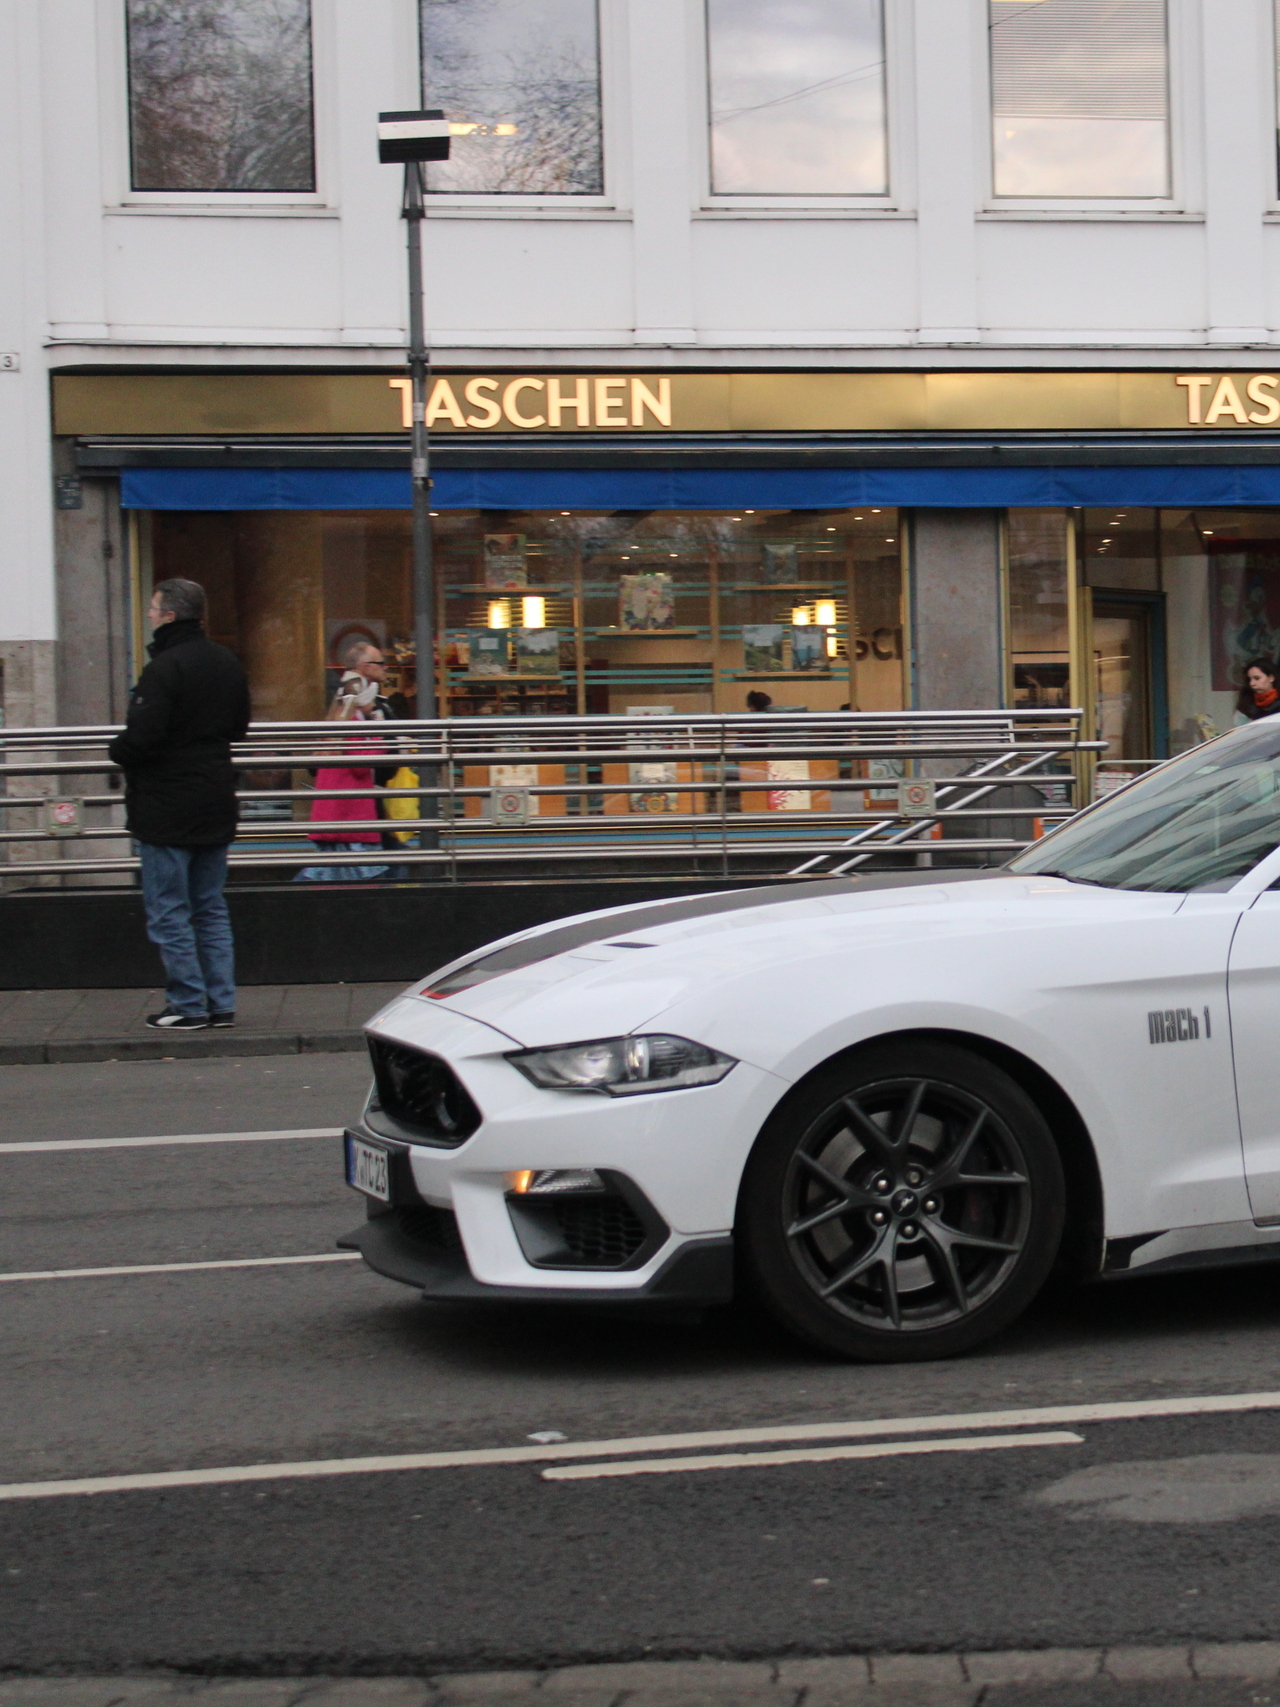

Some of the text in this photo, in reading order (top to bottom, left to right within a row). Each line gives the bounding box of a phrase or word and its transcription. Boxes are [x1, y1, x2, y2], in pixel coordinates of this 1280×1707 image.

[3, 355, 12, 368] 3
[388, 377, 672, 429] TASCHEN
[1204, 1005, 1211, 1038] 1
